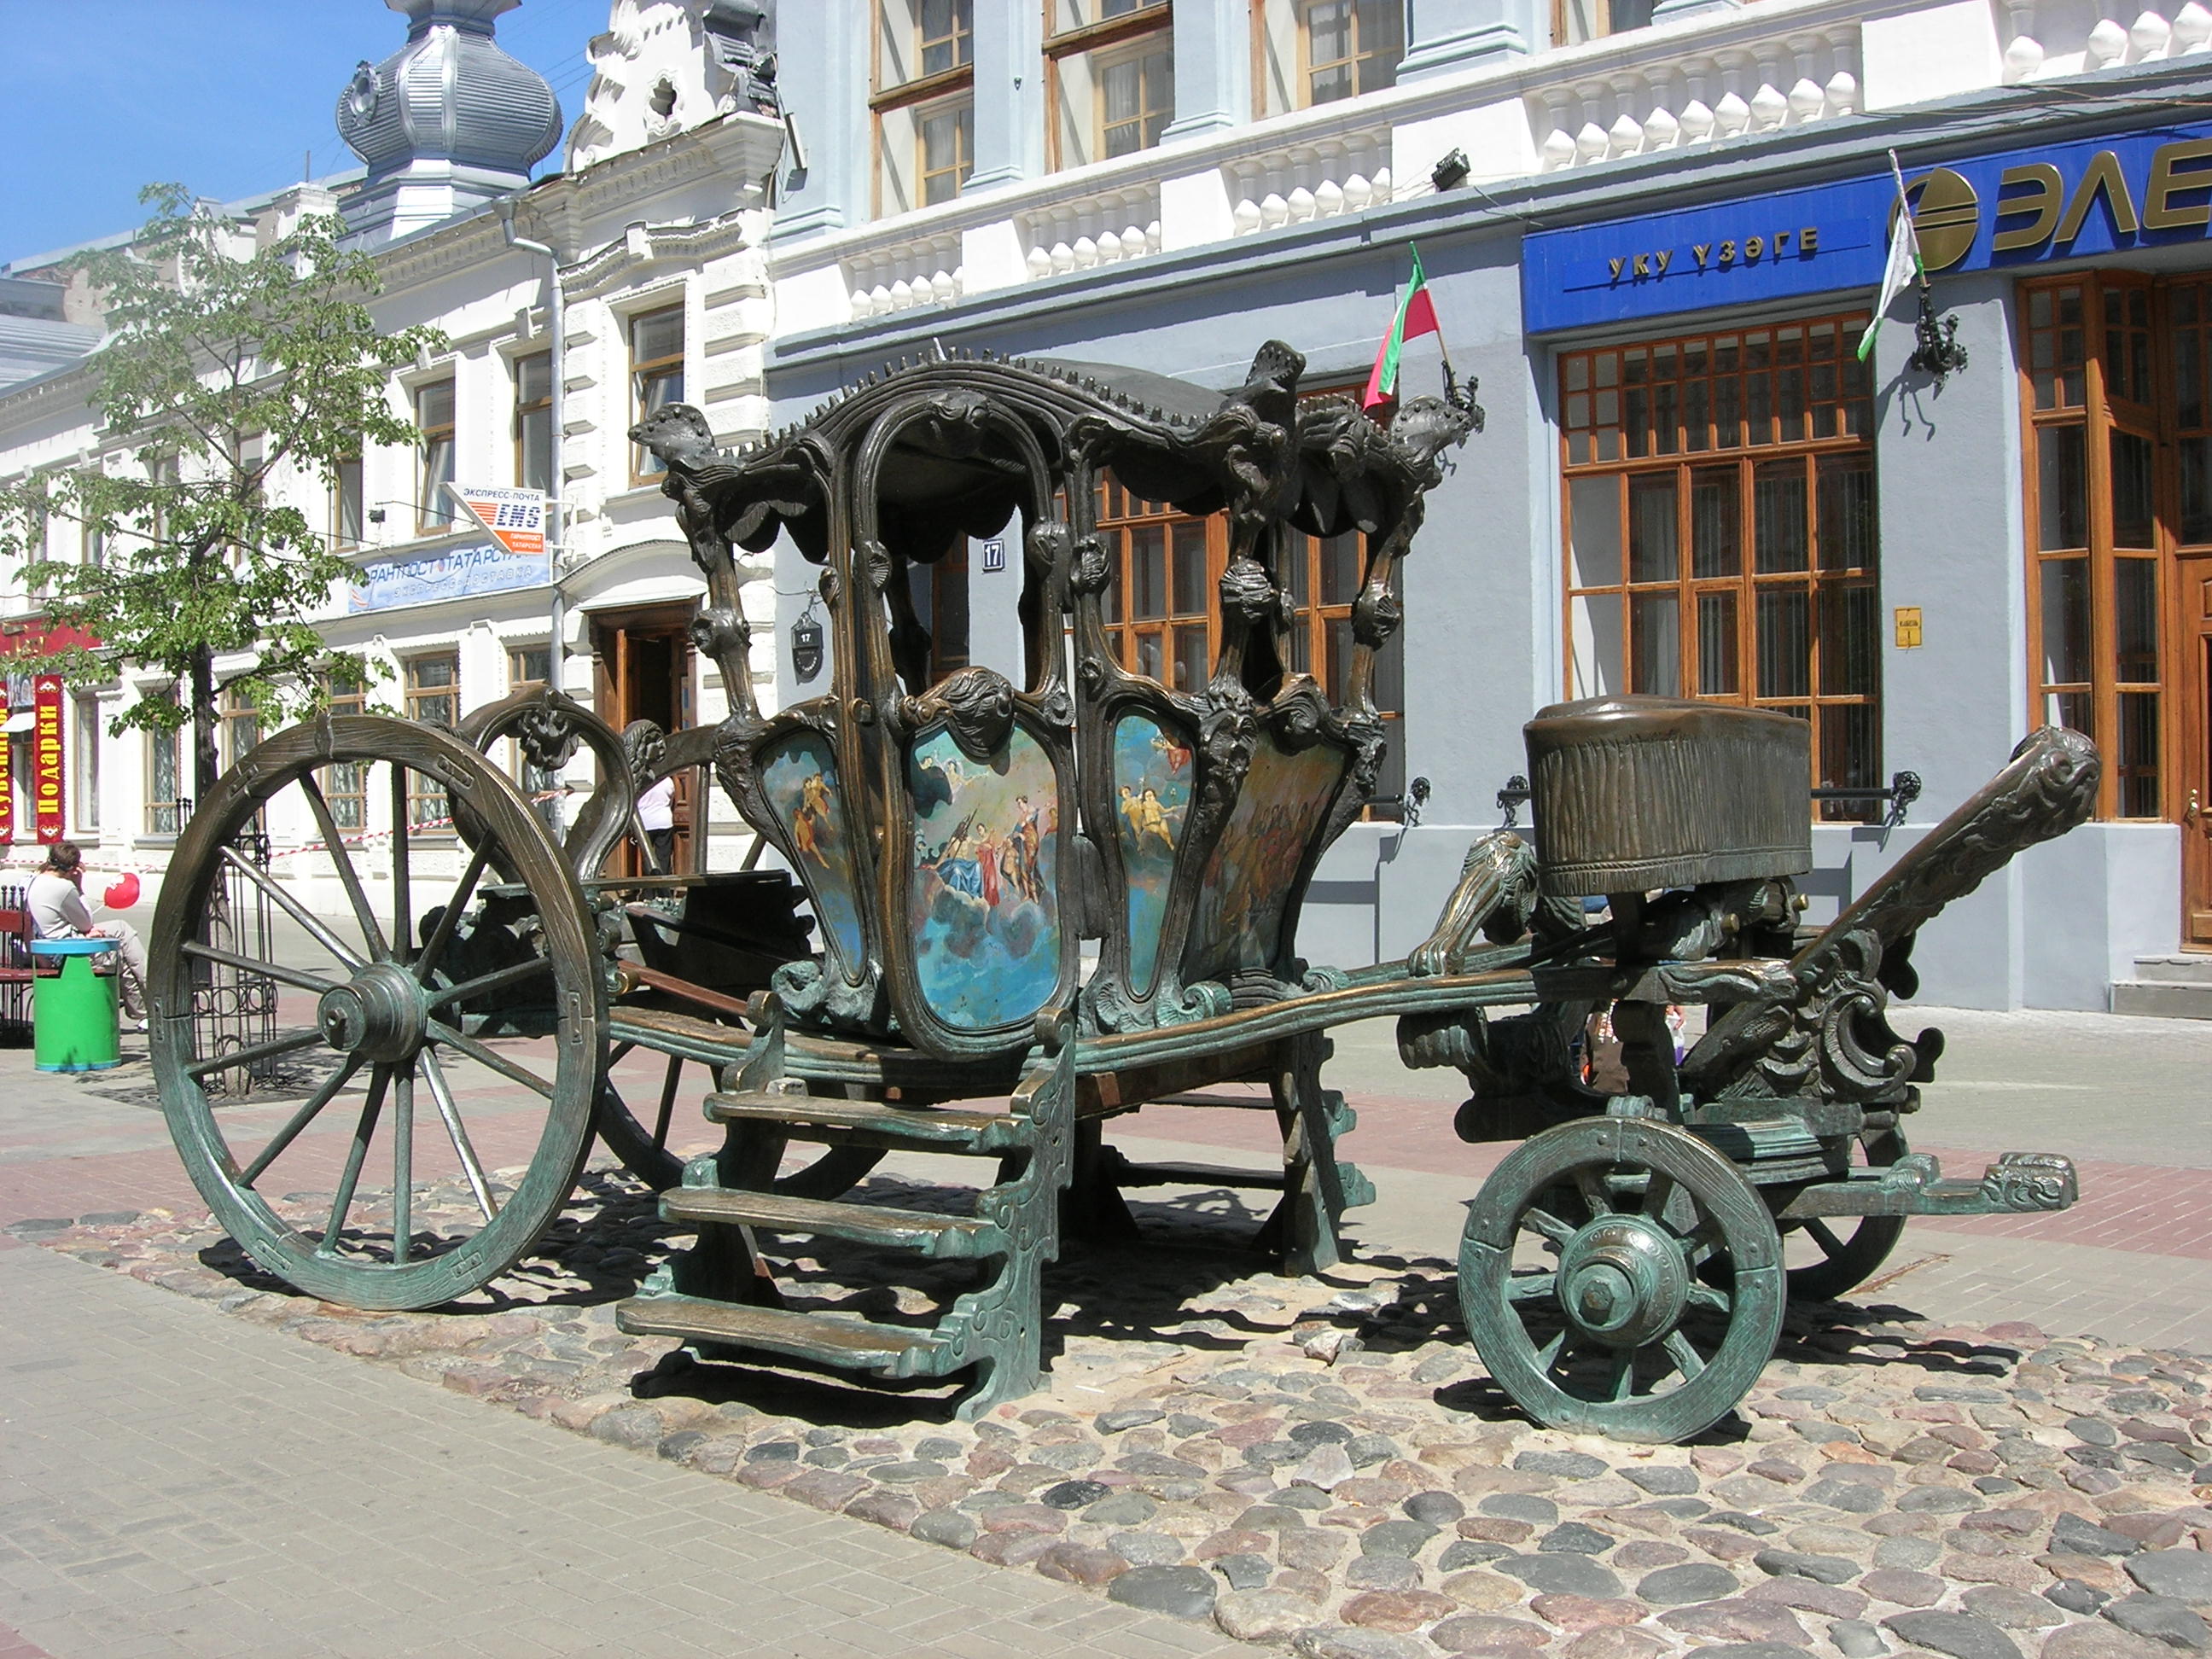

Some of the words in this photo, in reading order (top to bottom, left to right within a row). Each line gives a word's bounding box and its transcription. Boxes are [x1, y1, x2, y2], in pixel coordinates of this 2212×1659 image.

[1993, 137, 2212, 252] ЭЛЕ
[1609, 249, 1673, 279] УКУ
[463, 487, 540, 502] ЭКСПРЕСС-ПОЧТА
[497, 504, 541, 528] EMS
[984, 544, 999, 567] 17
[369, 559, 438, 584] РАНТПОСТ
[800, 633, 812, 643] 17
[38, 705, 61, 814] Подарки
